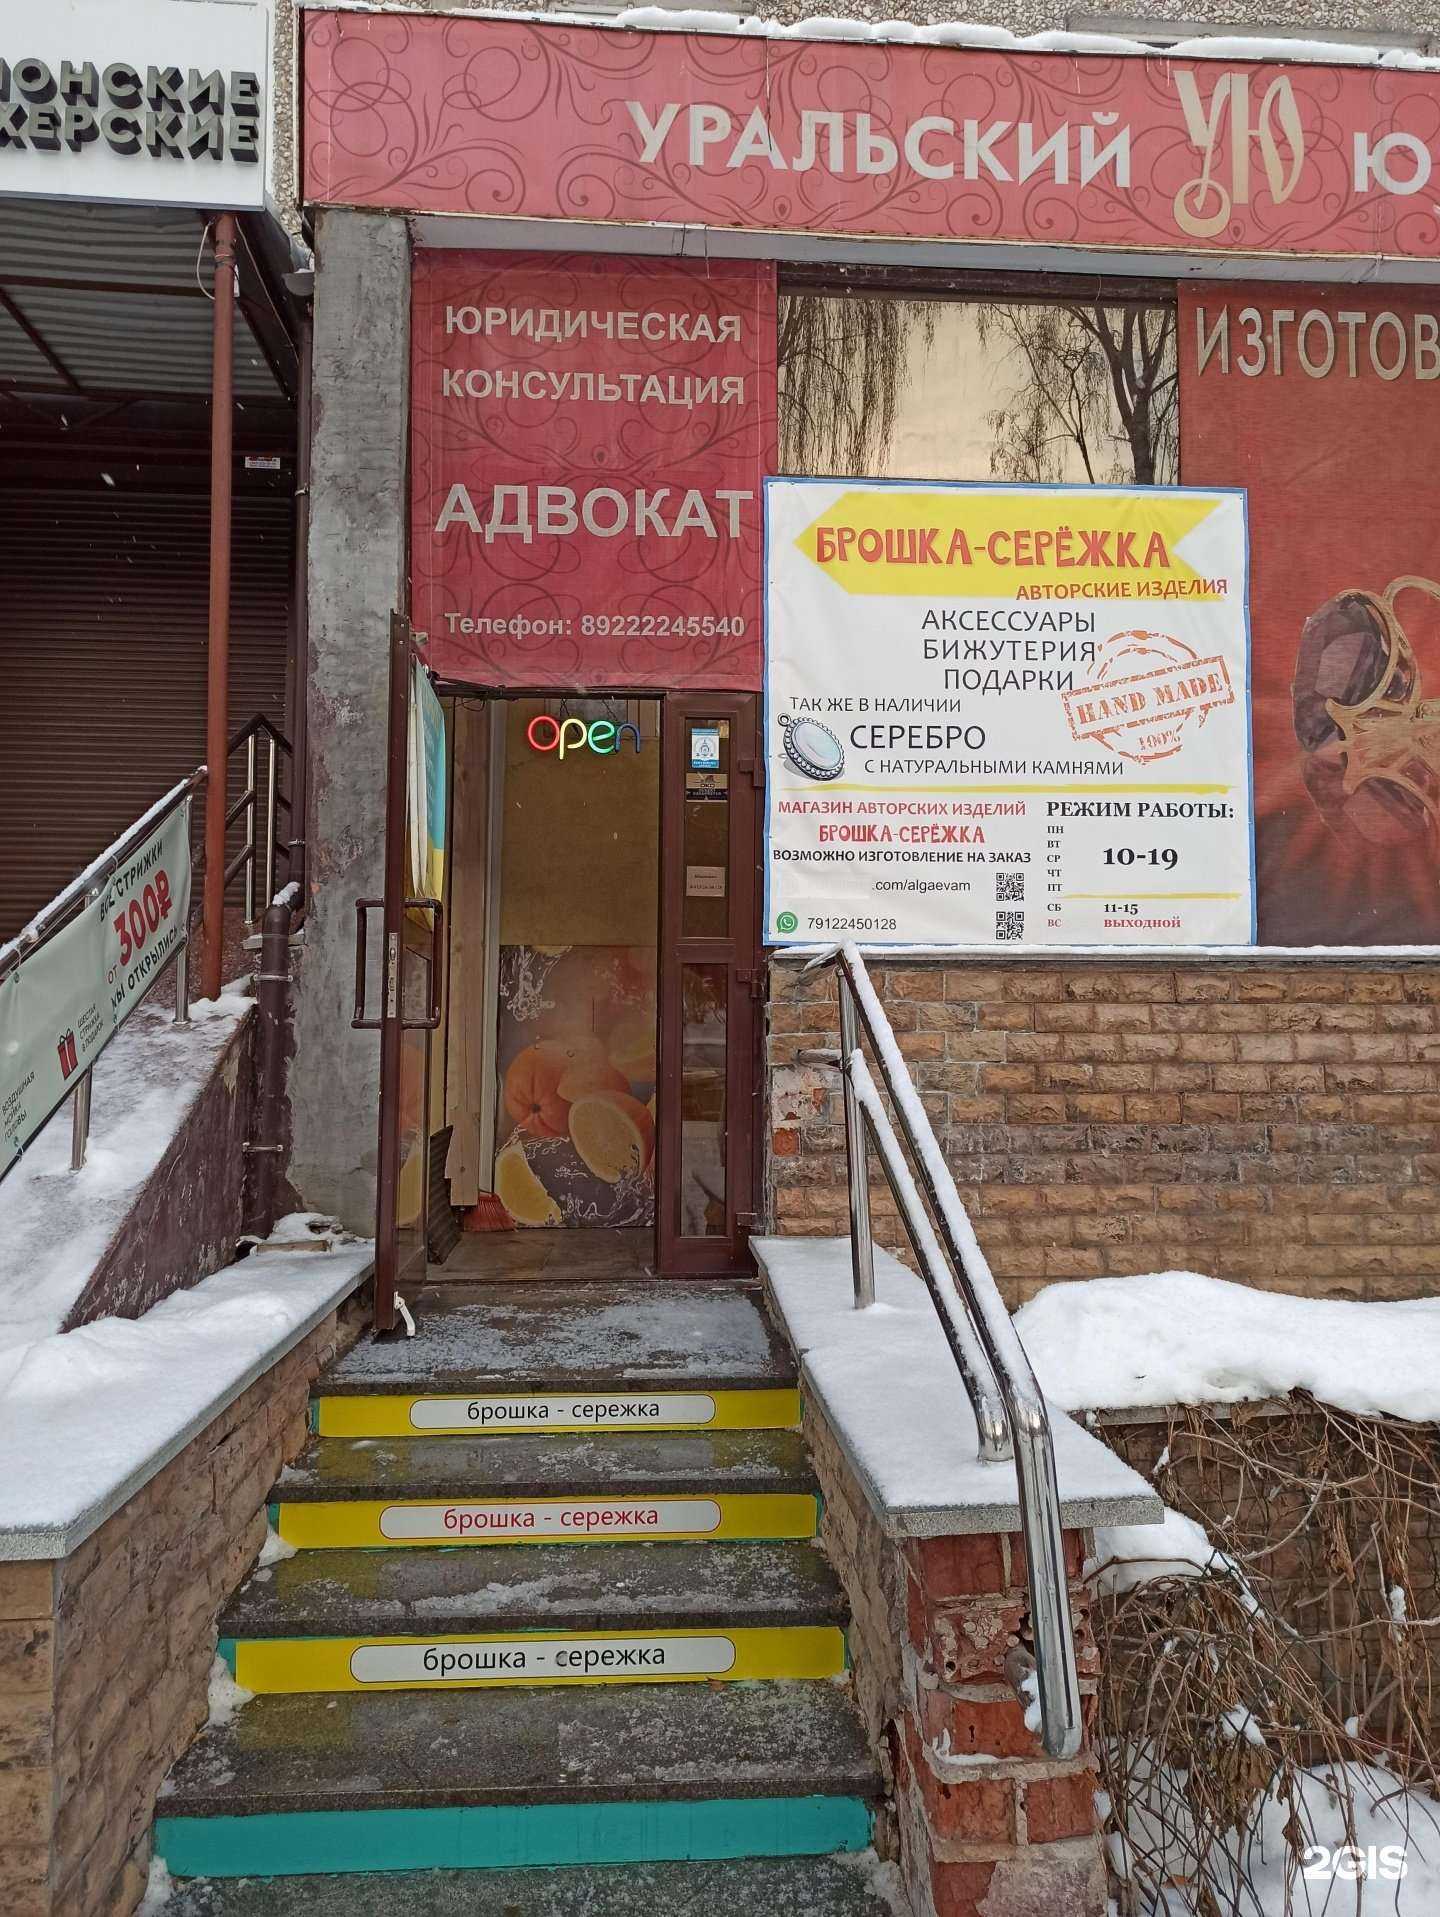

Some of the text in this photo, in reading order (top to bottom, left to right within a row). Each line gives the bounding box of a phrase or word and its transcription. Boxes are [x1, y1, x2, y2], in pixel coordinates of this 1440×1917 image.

[0, 57, 260, 116] ОНСКИЕ
[626, 101, 1130, 188] УРАЛЬСКИЙ
[1354, 132, 1431, 195] Ю
[446, 306, 741, 342] ЮРИДИЧЕСКАЯ
[1196, 304, 1440, 380] ИЗГОТОВ
[443, 369, 744, 409] КОНСУЛЬТАЦИЯ
[435, 483, 753, 544] АДВОКАТ
[816, 526, 1169, 569] БРОШКА-СЕРЁЖКА
[1016, 578, 1227, 601] АВТОРСКИЕ ИЗДЕЛИЯ
[444, 613, 745, 639] Телефон: 89222245540
[921, 610, 1095, 633] АКСЕССУАРЫ
[923, 639, 1096, 661] БИЖУТЕРИЯ
[945, 669, 1073, 695] ПОДАРКИ
[789, 697, 961, 713] ТАК ЖЕ В НАЛИЧИИ
[1076, 673, 1223, 725] HAND MADE
[850, 725, 986, 750] СЕРЕБРО
[864, 759, 1124, 775] С НАТУРАЛЬНЫМИ КАМНЯМИ
[778, 801, 1026, 818] МАГАЗИН АВТОРСКИХ ИЗДЕЛИЙ
[1046, 801, 1234, 818] РЕЖИМ РАБОТЫ:
[819, 823, 985, 844] БРОШКА-СЕРЁЖКА
[1047, 825, 1064, 834] ПН
[1047, 840, 1061, 848] ВТ
[115, 838, 164, 897] СТРИЖКИ
[773, 850, 1031, 864] ВОЗМОЖНО ИЗГОТОВЛЕНИЕ НА ЗАКАЗ
[1047, 854, 1061, 863] СР
[1103, 848, 1178, 870] 10-19
[1047, 868, 1062, 877] ЧТ
[1047, 883, 1063, 892] ПТ
[1047, 903, 1138, 915] СБ 11-15
[808, 917, 897, 930] 79122450128
[1047, 918, 1062, 927] ВС
[127, 923, 178, 991] ОТКРЫЛИСЬ
[467, 1401, 549, 1426] брошка
[572, 1401, 660, 1424] сережка
[444, 1509, 535, 1535] брошка
[560, 1507, 658, 1531] сережка
[423, 1648, 527, 1677] брошка
[555, 1646, 665, 1671] сережка
